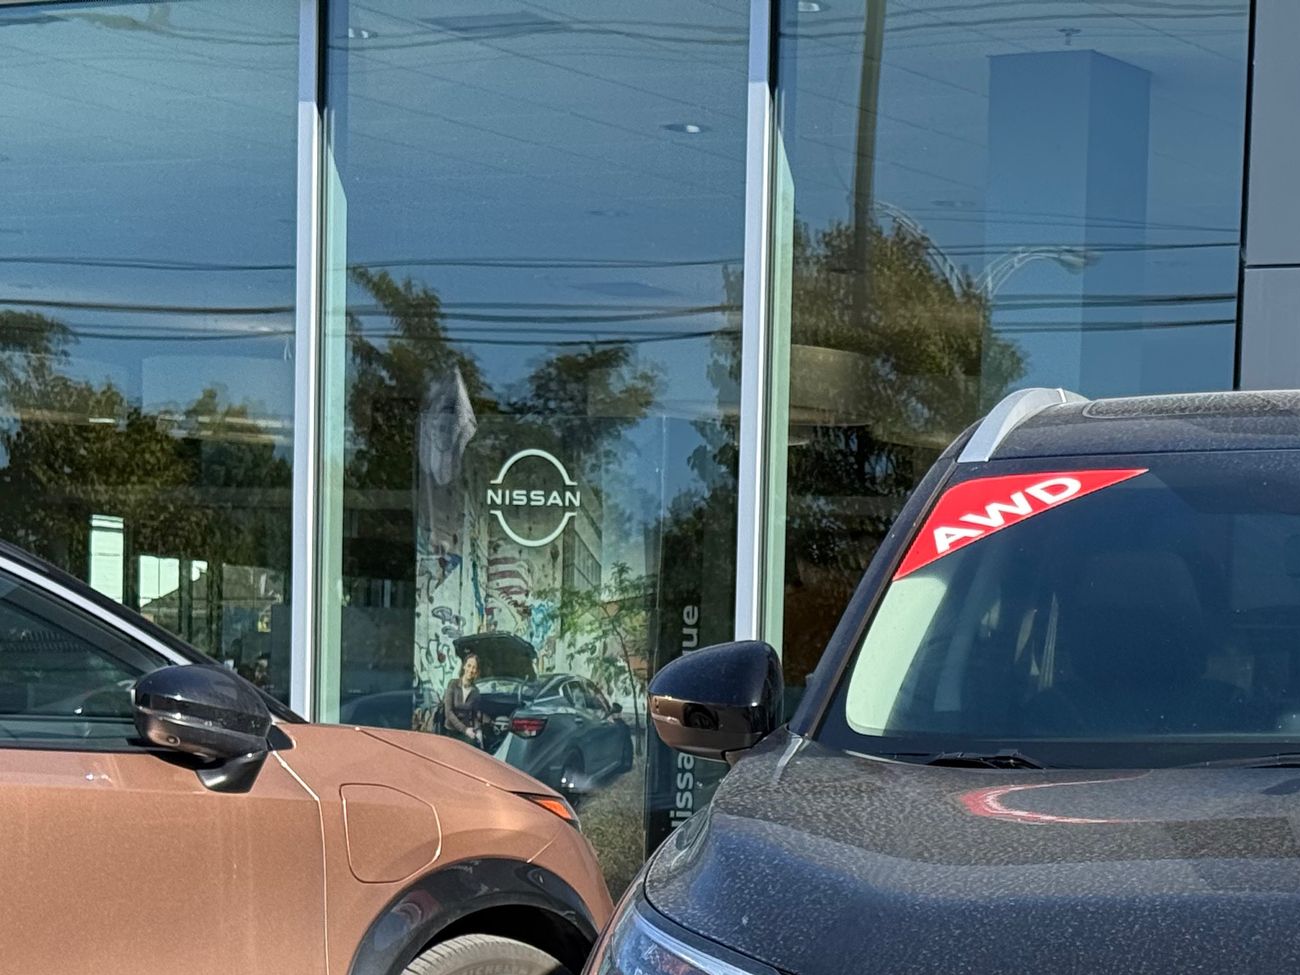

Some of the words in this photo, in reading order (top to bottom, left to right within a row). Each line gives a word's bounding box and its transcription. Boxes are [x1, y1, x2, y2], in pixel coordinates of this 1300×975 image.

[486, 488, 581, 507] NISSAN
[933, 477, 1082, 554] AWD
[669, 752, 696, 829] issa
